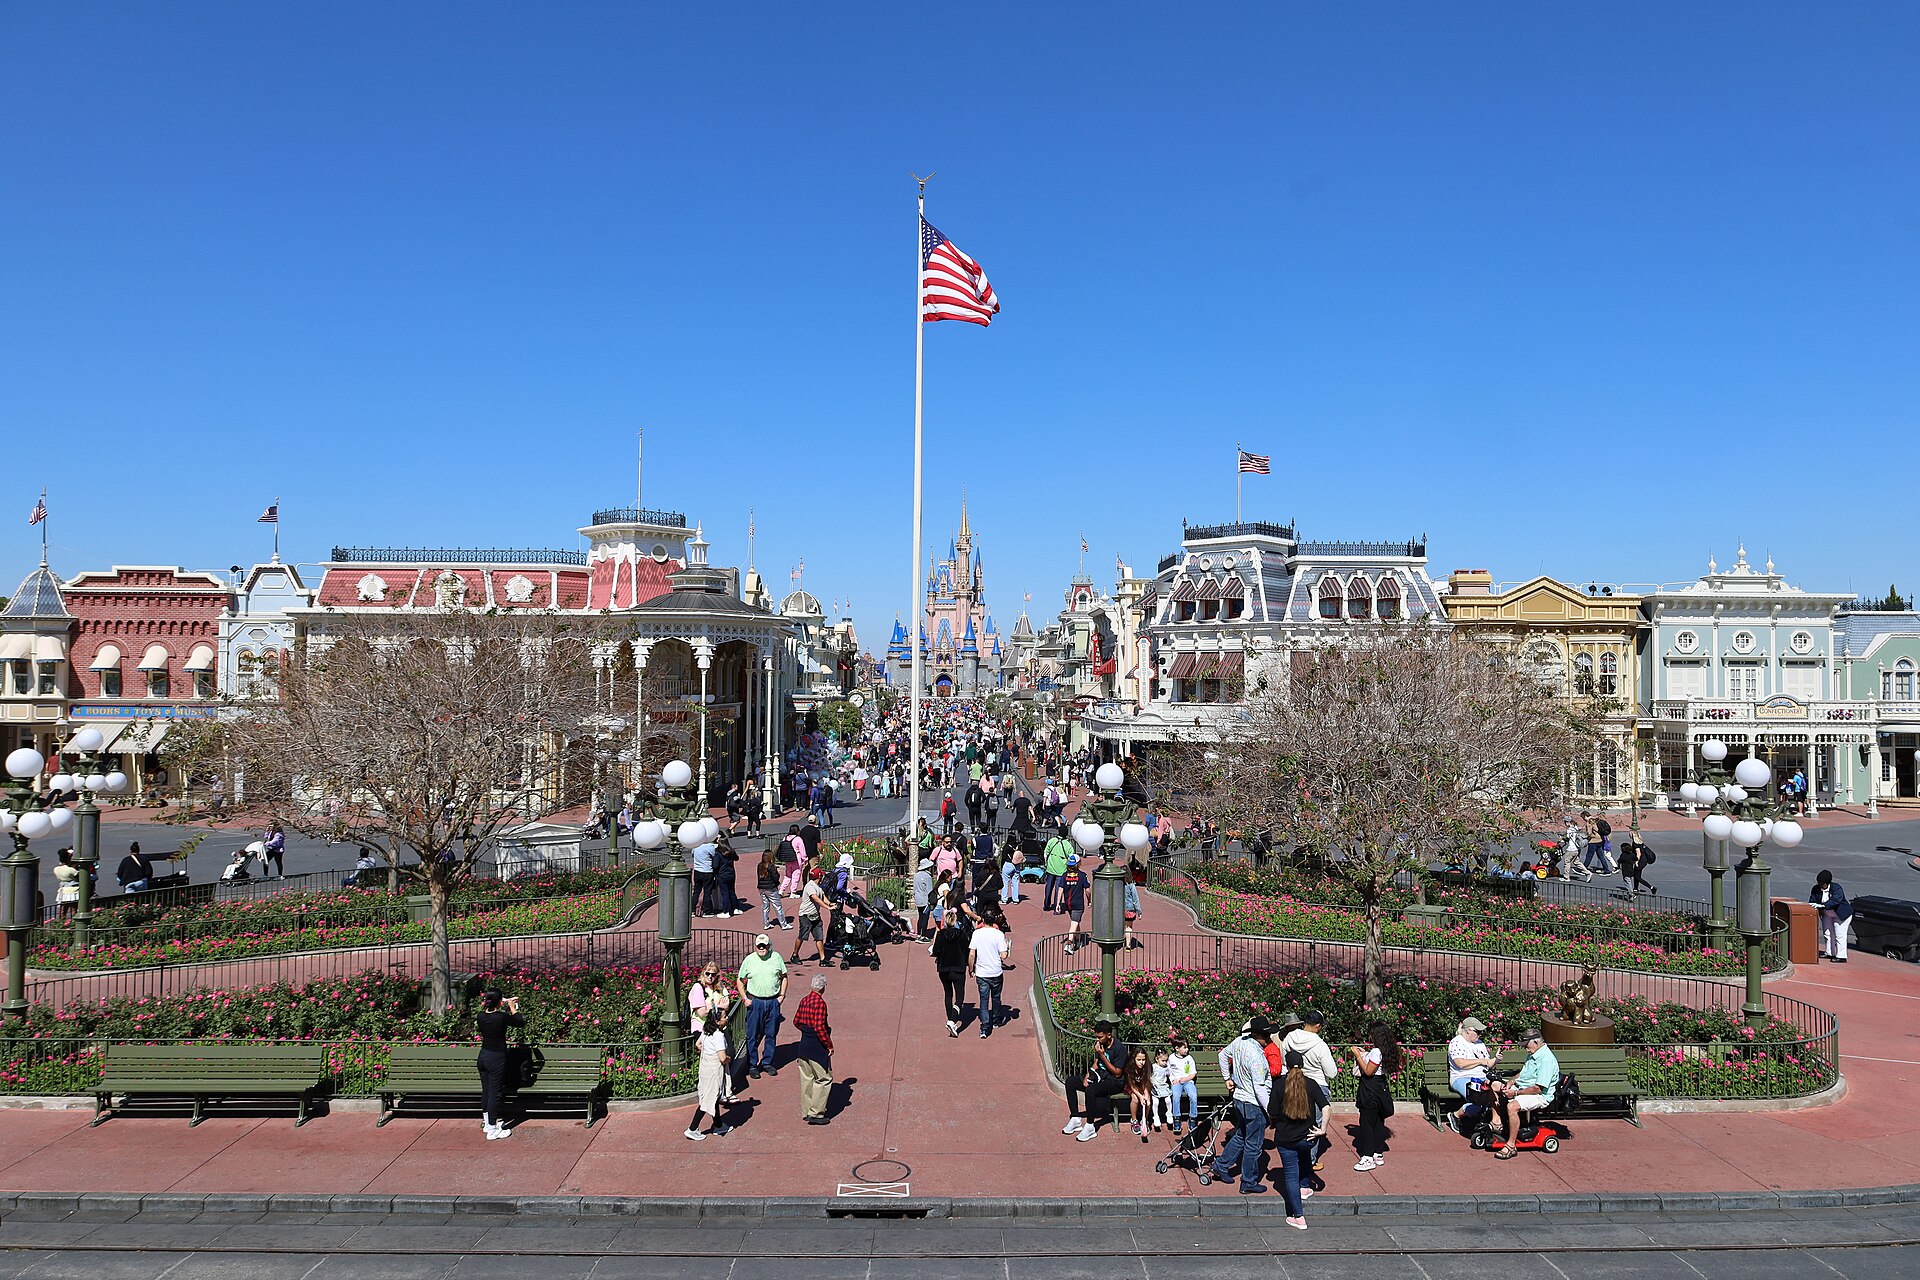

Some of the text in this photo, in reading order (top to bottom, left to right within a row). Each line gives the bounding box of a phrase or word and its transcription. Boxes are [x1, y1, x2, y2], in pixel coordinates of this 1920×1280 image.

[86, 707, 120, 715] BOOKS
[133, 707, 161, 715] TOYS
[1759, 706, 1803, 715] CONFECTIONERY
